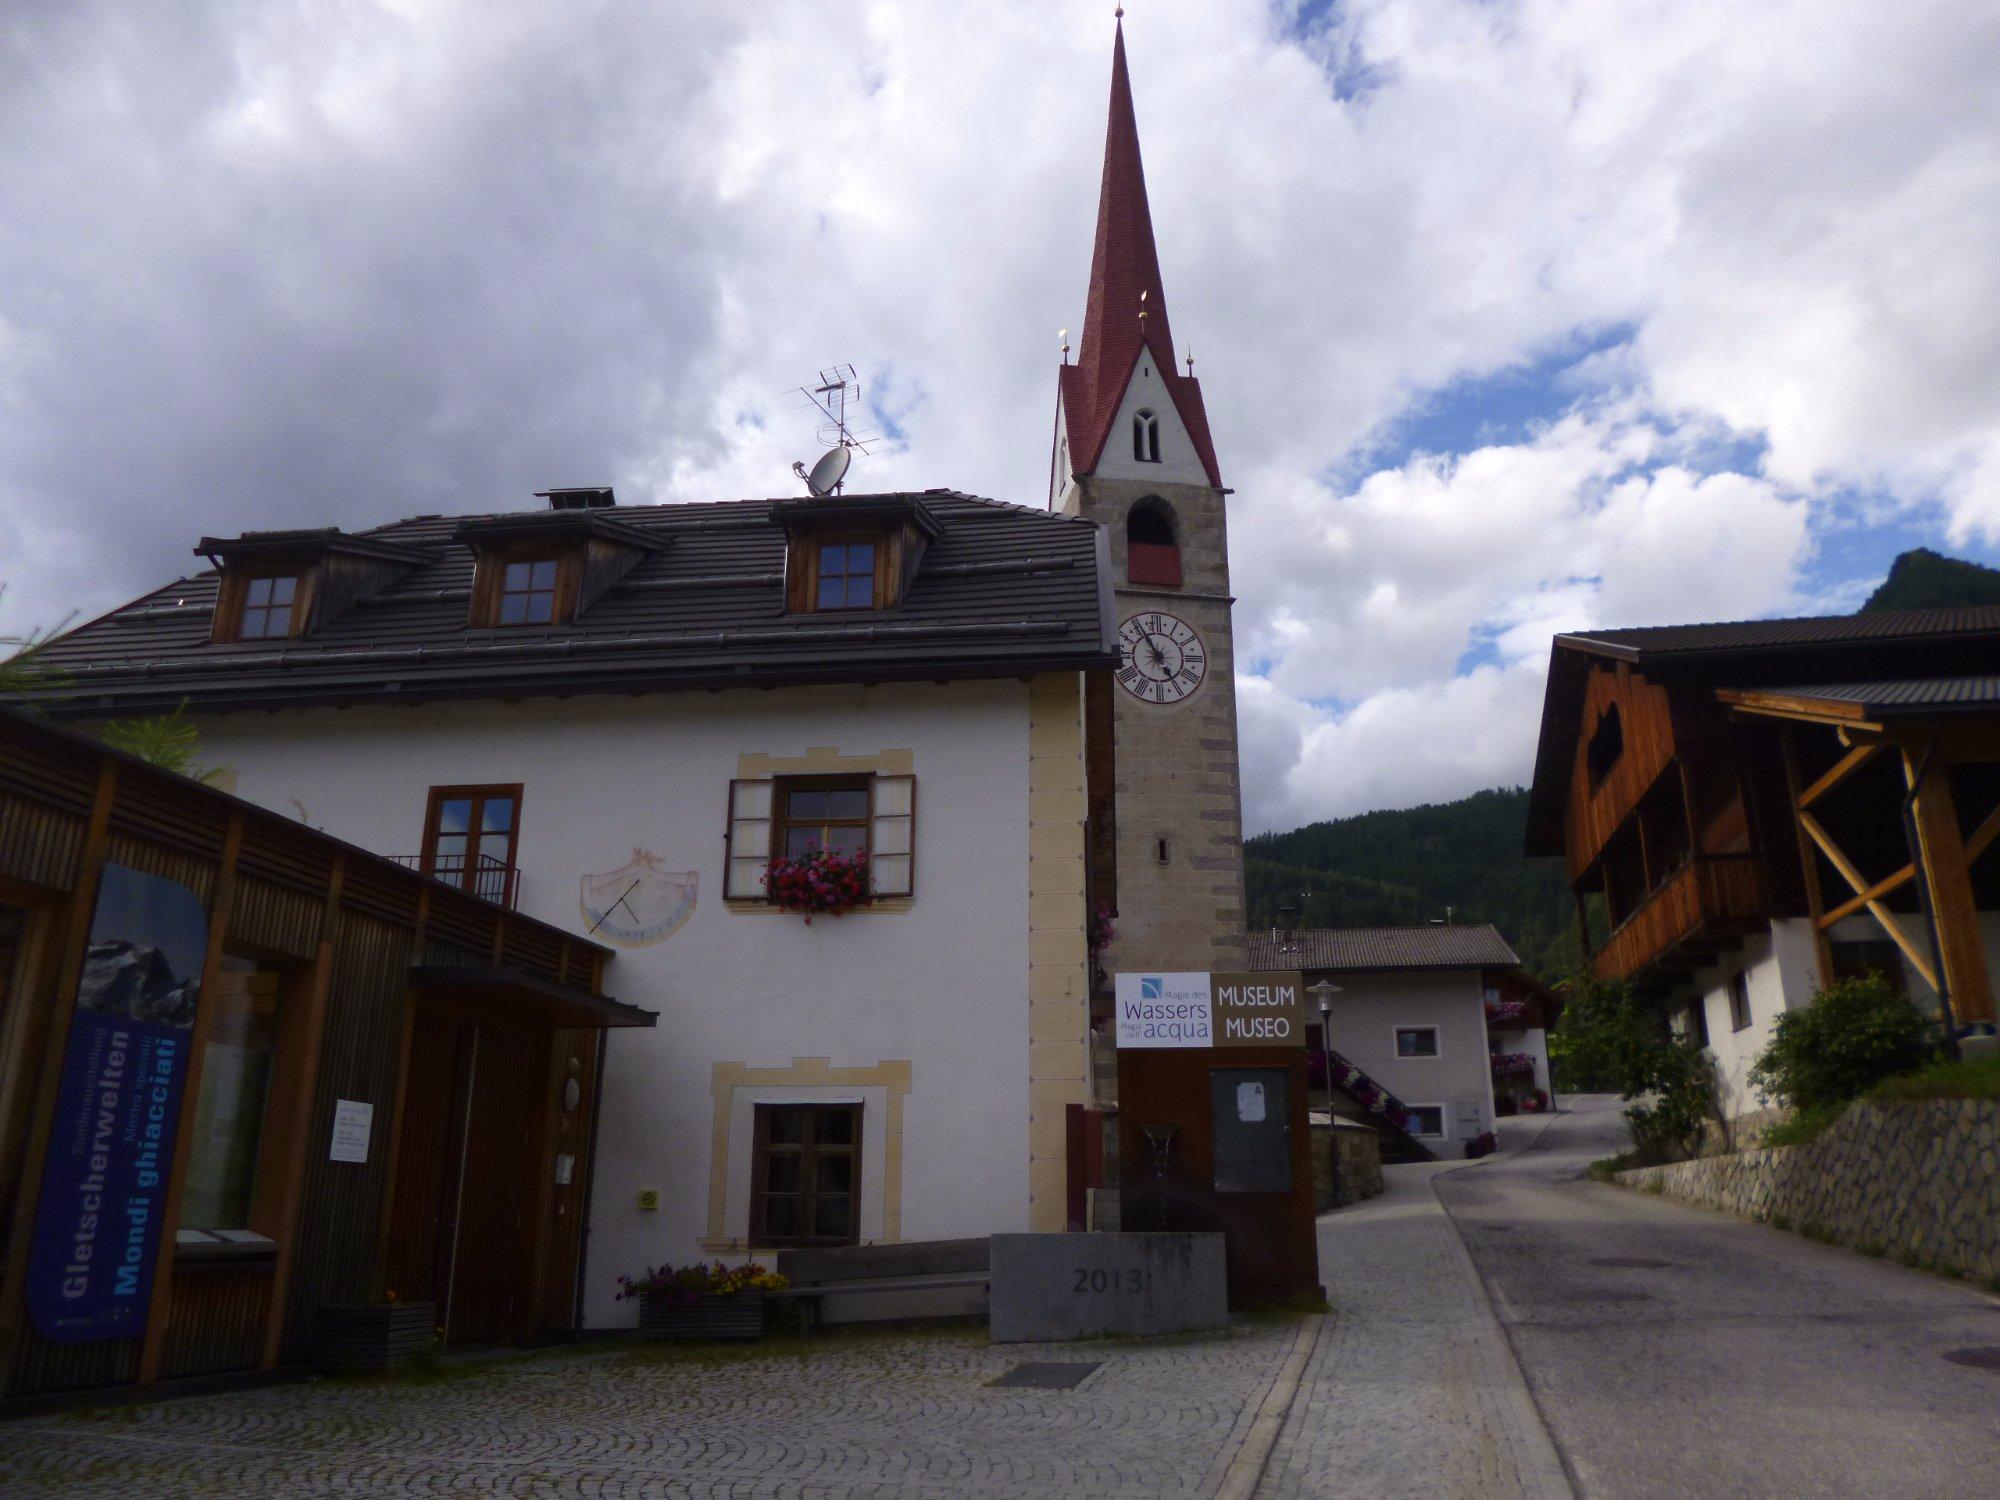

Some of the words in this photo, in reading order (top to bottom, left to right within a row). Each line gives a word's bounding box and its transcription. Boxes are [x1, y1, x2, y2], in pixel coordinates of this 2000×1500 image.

[1164, 990, 1188, 1001] Magie
[1191, 990, 1208, 999] des
[1217, 985, 1295, 1007] MUSEUM
[1124, 1000, 1208, 1020] Wassers
[1143, 1021, 1209, 1043] acqua
[1225, 1016, 1290, 1039] MUSEO
[61, 1030, 131, 1299] Gletscherwelten
[113, 1196, 151, 1297] Mondi
[134, 1036, 177, 1189] ghiacciati
[1073, 1268, 1142, 1294] 2013
